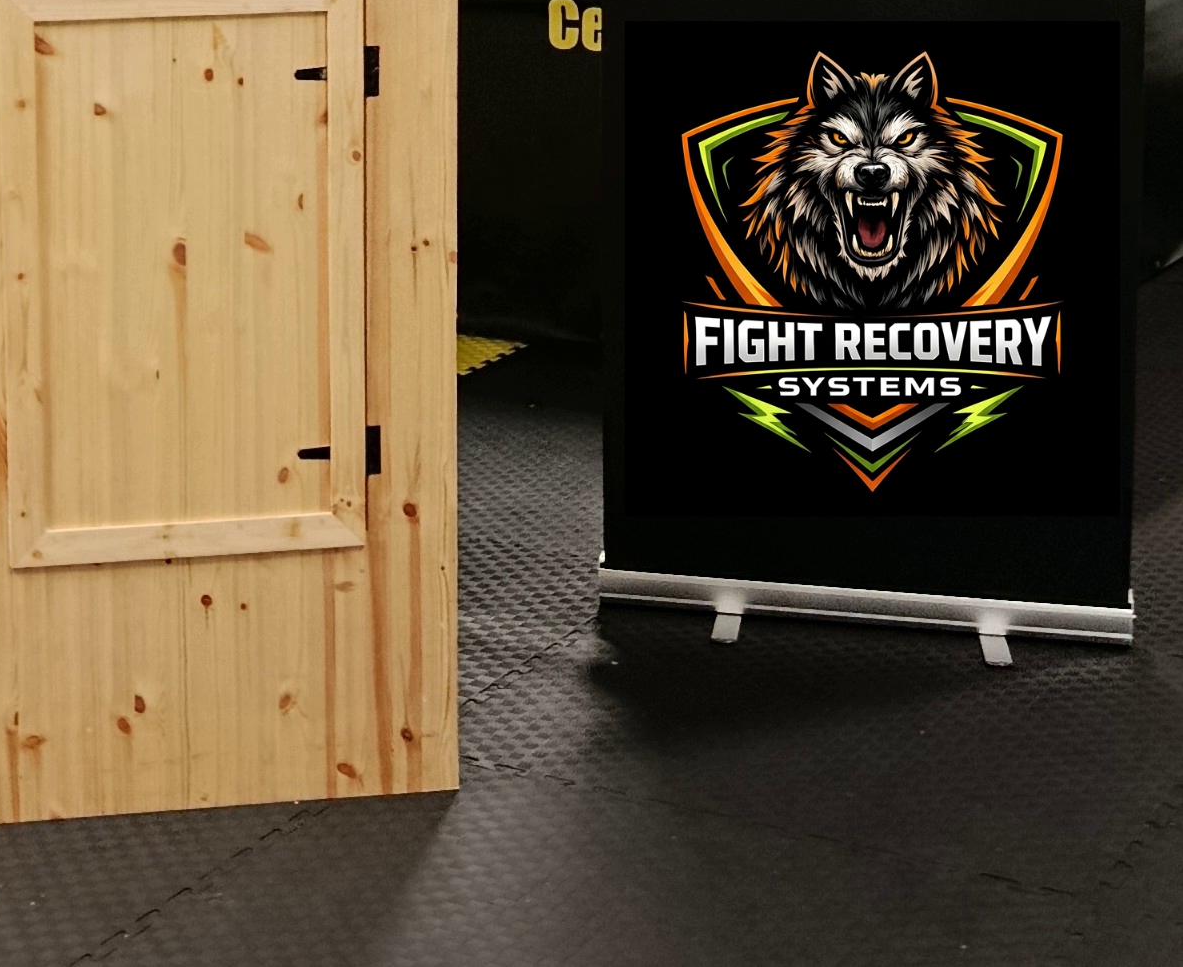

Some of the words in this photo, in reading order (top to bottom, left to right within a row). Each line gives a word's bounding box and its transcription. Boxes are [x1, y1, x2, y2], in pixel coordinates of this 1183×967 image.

[694, 316, 824, 366] FIGHT
[834, 315, 1053, 367] RECOVERY
[778, 376, 962, 397] SYSTEMS
